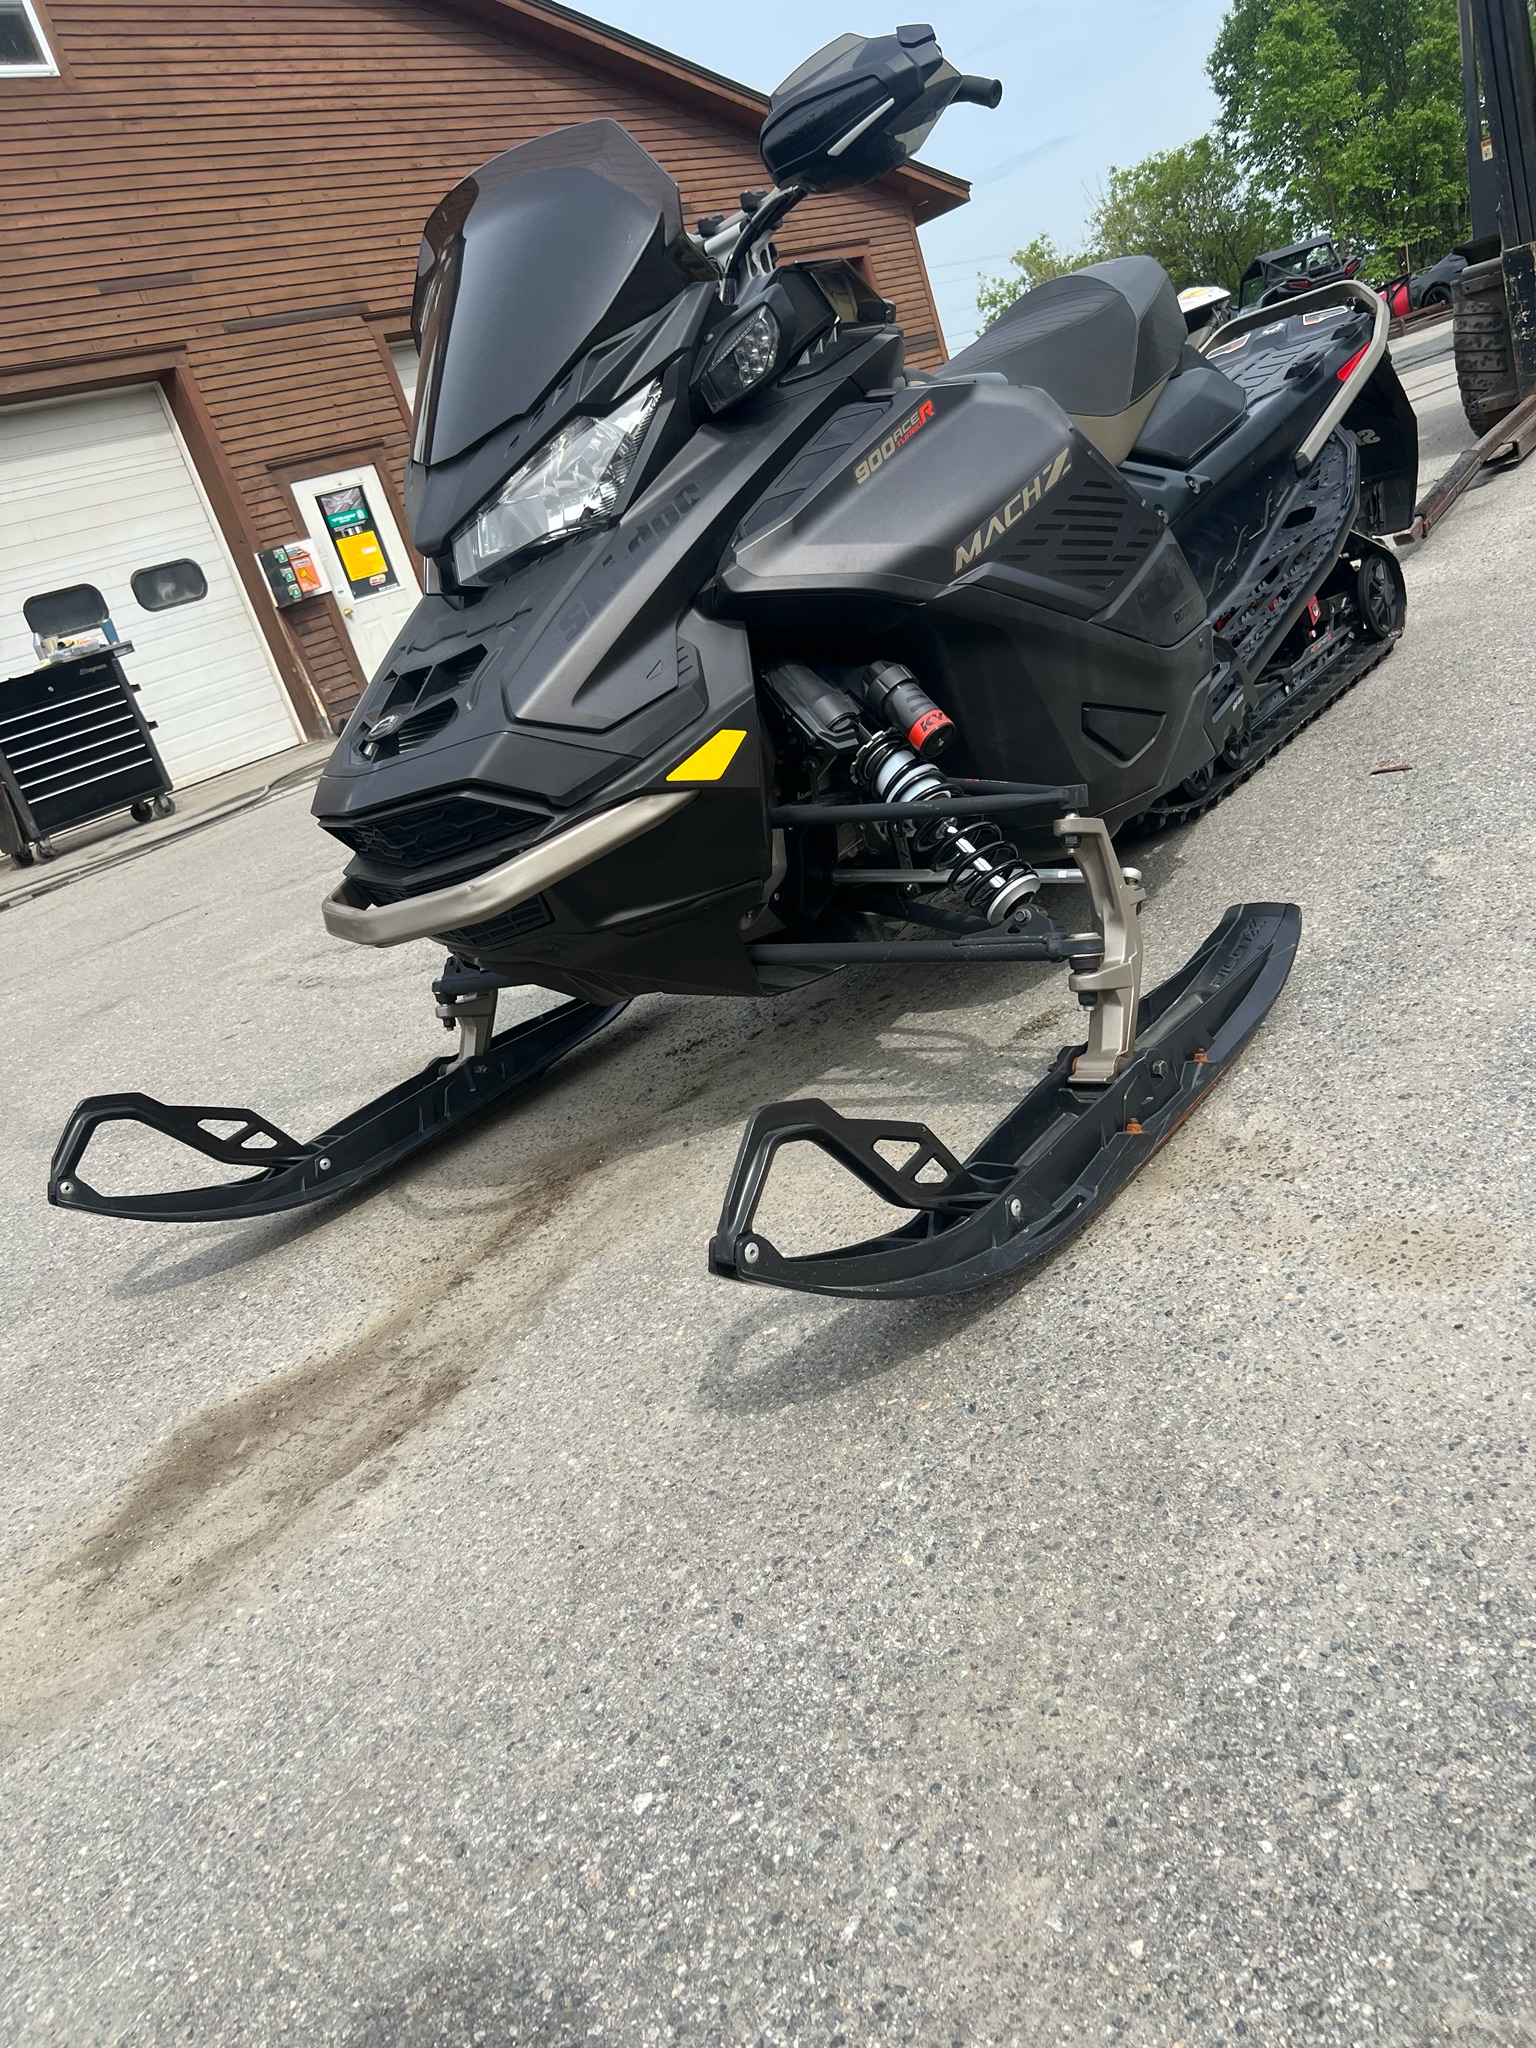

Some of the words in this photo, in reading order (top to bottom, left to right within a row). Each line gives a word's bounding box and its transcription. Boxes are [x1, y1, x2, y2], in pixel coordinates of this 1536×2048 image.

[854, 436, 896, 484] 900
[893, 411, 920, 442] ACE
[918, 400, 935, 424] R
[896, 420, 922, 448] TURBO
[954, 476, 1041, 573] MACH
[920, 712, 949, 733] KY
